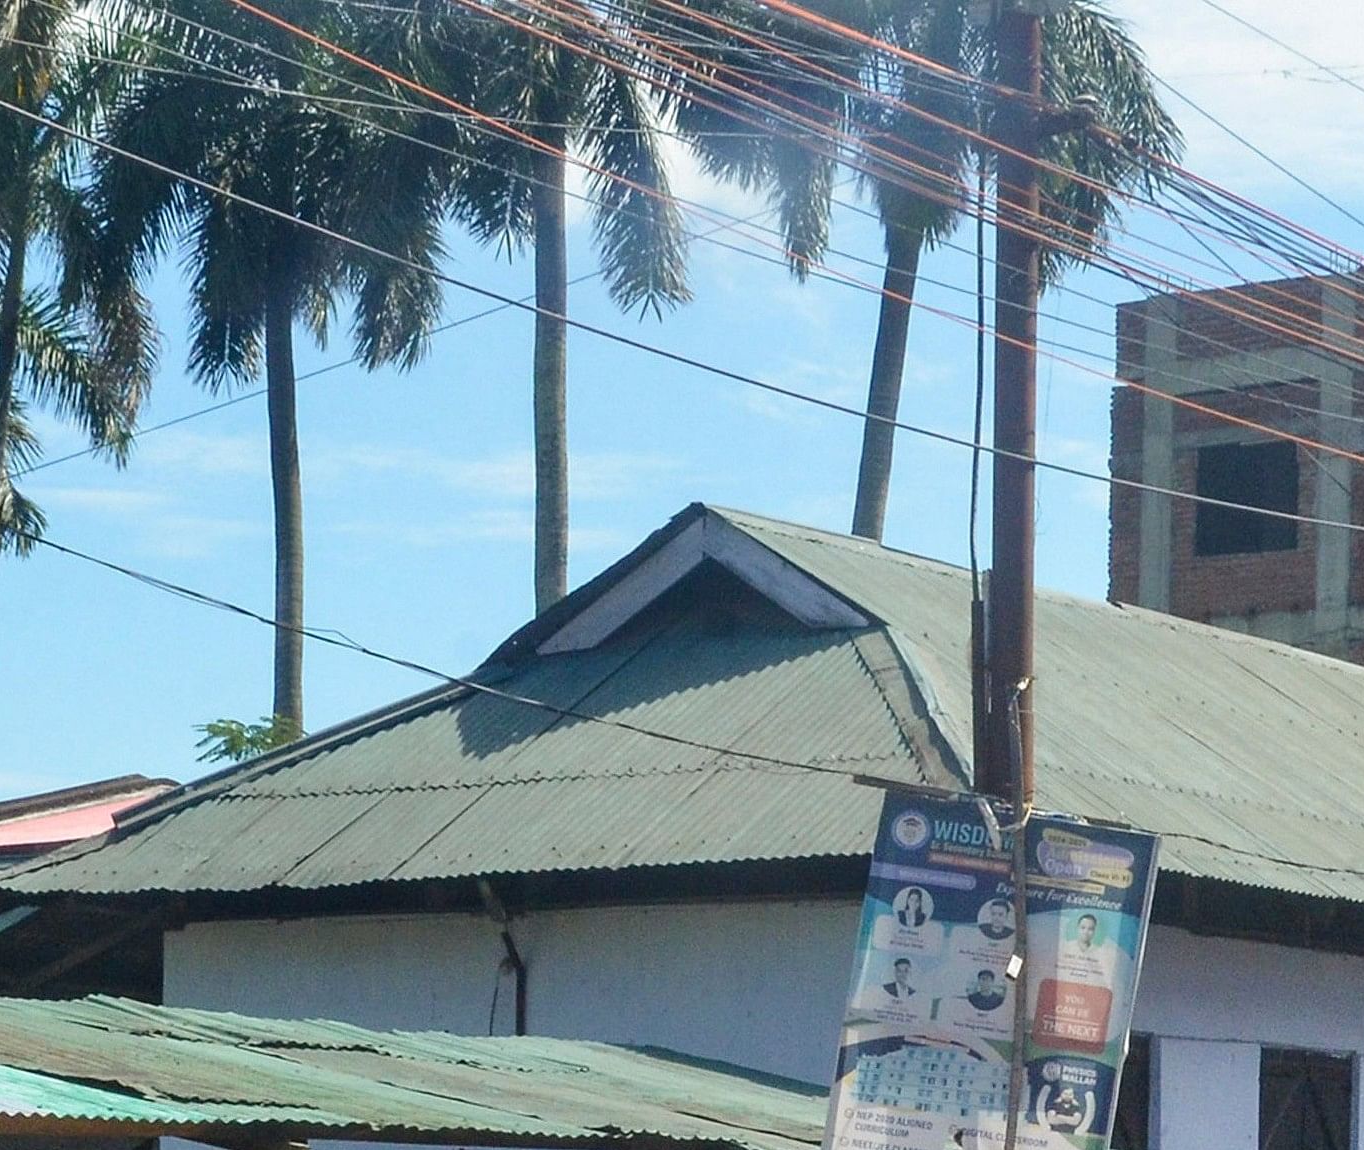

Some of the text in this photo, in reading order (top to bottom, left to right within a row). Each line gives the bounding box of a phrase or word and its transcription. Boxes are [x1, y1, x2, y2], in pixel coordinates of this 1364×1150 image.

[1042, 1020, 1101, 1038] THE NEXT
[856, 1110, 873, 1120] NEP
[896, 1117, 934, 1130] ALIGNED
